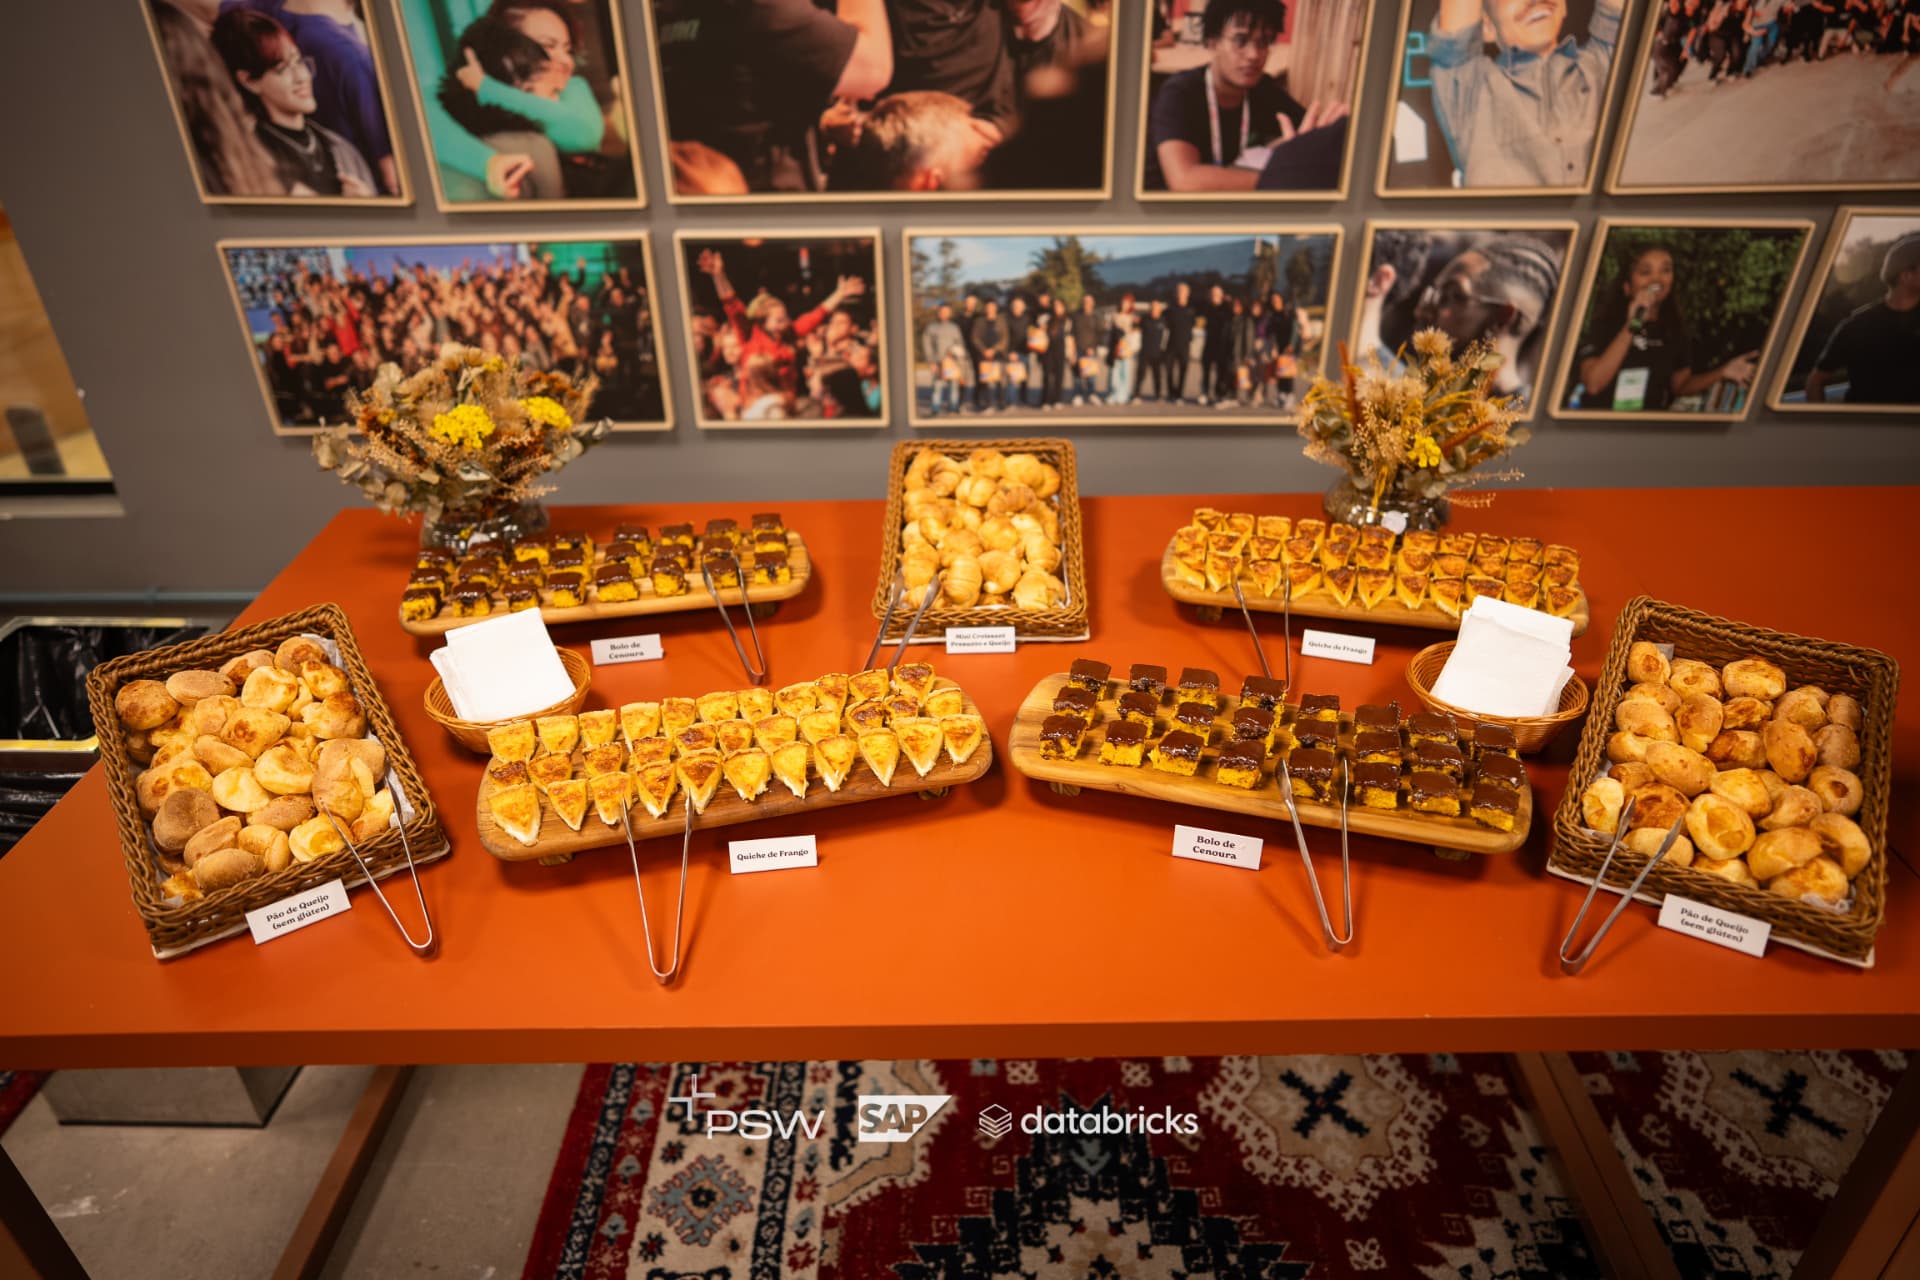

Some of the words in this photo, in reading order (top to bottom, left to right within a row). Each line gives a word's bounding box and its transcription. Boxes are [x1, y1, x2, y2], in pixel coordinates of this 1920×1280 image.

[1192, 846, 1236, 860] Cenoura
[1196, 835, 1220, 846] Bolo
[1222, 840, 1236, 848] de
[736, 852, 766, 861] Quiche
[780, 848, 808, 857] Frango
[266, 911, 285, 922] Pão
[286, 906, 298, 914] de
[298, 894, 329, 910] Queijo
[272, 917, 296, 930] (sem
[297, 903, 330, 921] glúten)
[1680, 907, 1700, 919] Pão
[1700, 914, 1714, 924] de
[1715, 918, 1749, 934] Queijo
[1680, 918, 1704, 931] (sem
[1706, 926, 1744, 943] glúten)
